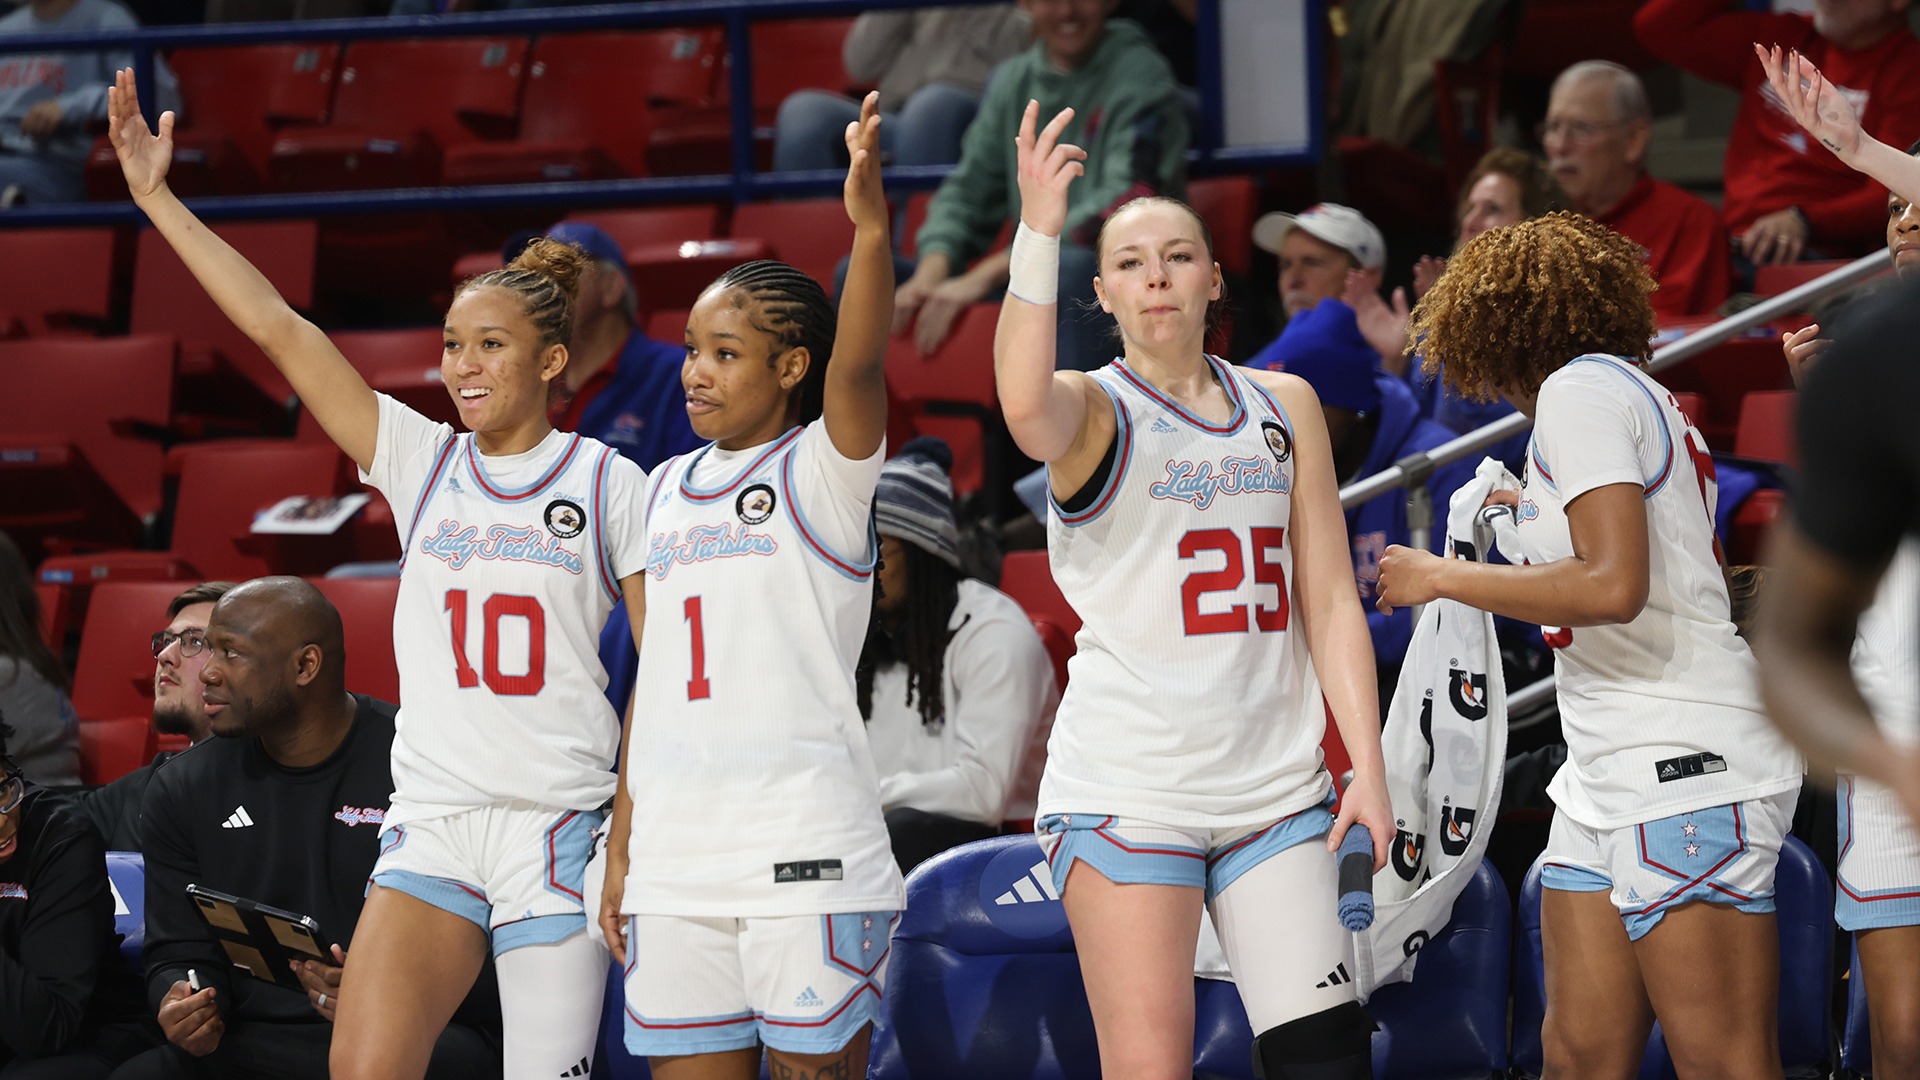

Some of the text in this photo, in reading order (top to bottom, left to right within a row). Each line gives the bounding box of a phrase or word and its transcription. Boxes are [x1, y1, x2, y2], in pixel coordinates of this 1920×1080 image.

[1149, 455, 1291, 511] Lady Techste
[421, 519, 583, 575] Lady Techsters
[676, 521, 778, 565] Techsters
[1177, 525, 1290, 637] 25
[443, 587, 546, 697] 10
[683, 594, 711, 702] 1
[793, 999, 824, 1008] adidas
